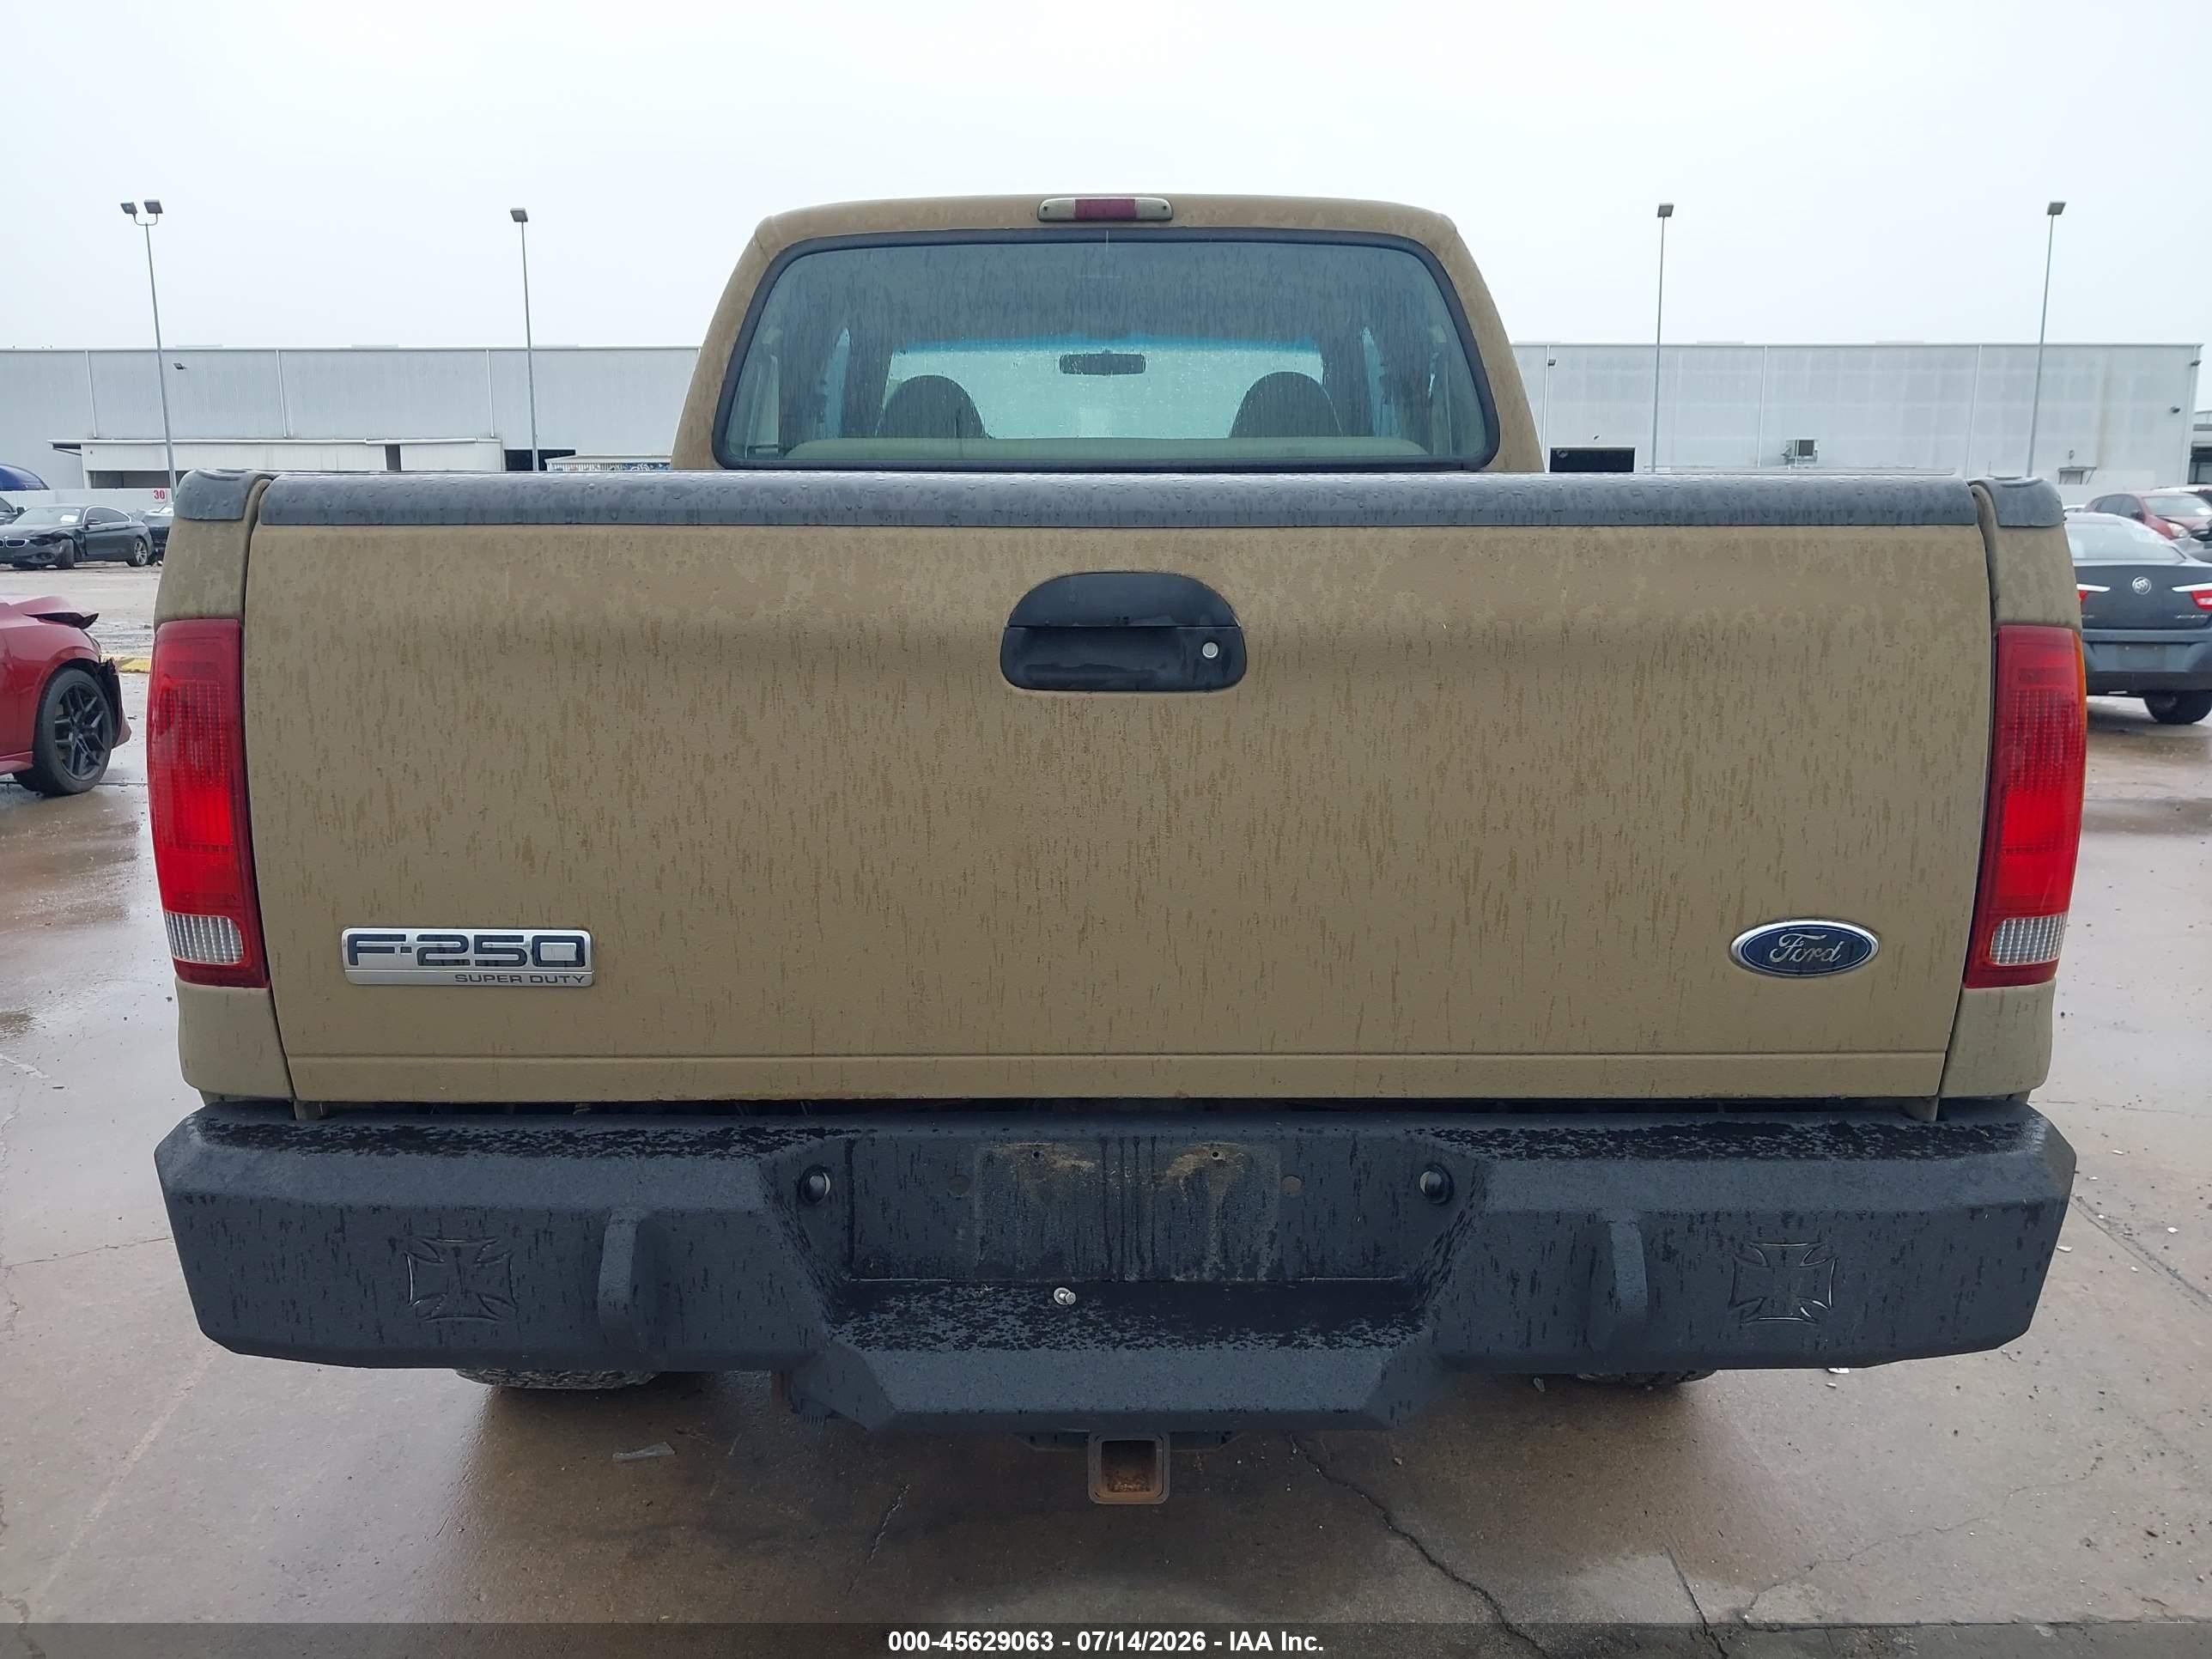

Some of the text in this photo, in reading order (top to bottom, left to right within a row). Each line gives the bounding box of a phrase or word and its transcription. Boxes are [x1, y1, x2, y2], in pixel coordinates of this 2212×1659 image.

[153, 489, 166, 500] 30
[347, 933, 586, 968] F-250
[1769, 933, 1842, 963] Ford
[454, 974, 586, 984] SUPER DUTY
